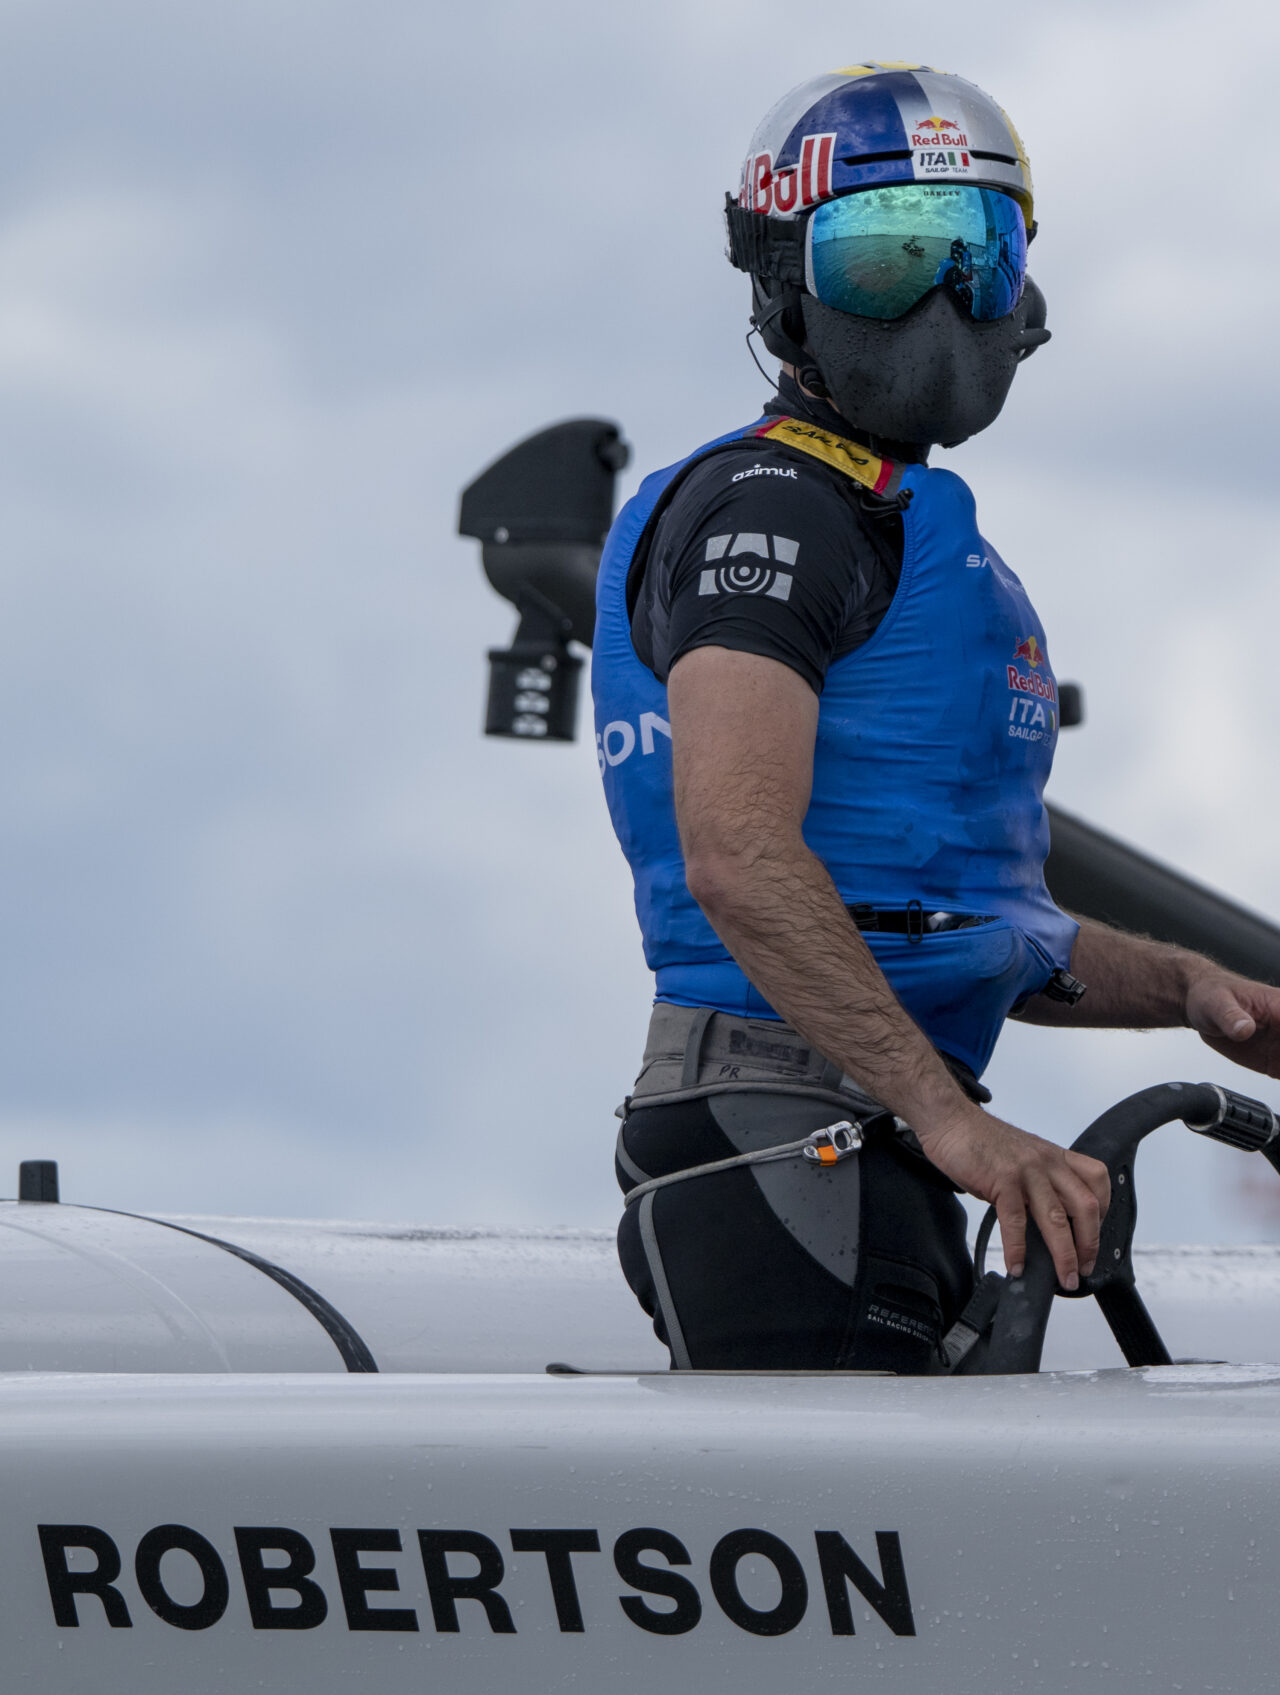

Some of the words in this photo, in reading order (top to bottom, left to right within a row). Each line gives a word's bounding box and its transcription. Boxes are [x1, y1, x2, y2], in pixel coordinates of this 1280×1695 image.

[911, 133, 940, 146] Red
[941, 133, 968, 146] Bull
[920, 152, 947, 166] ITA
[752, 135, 834, 215] Bull
[732, 464, 798, 482] azimut
[1007, 665, 1035, 695] Red
[1035, 672, 1056, 703] Bull
[1008, 697, 1046, 729] ITA
[718, 1064, 741, 1079] PR
[867, 1313, 885, 1325] SAIL
[886, 1319, 912, 1334] RACING
[37, 1523, 917, 1637] ROBERTSON
